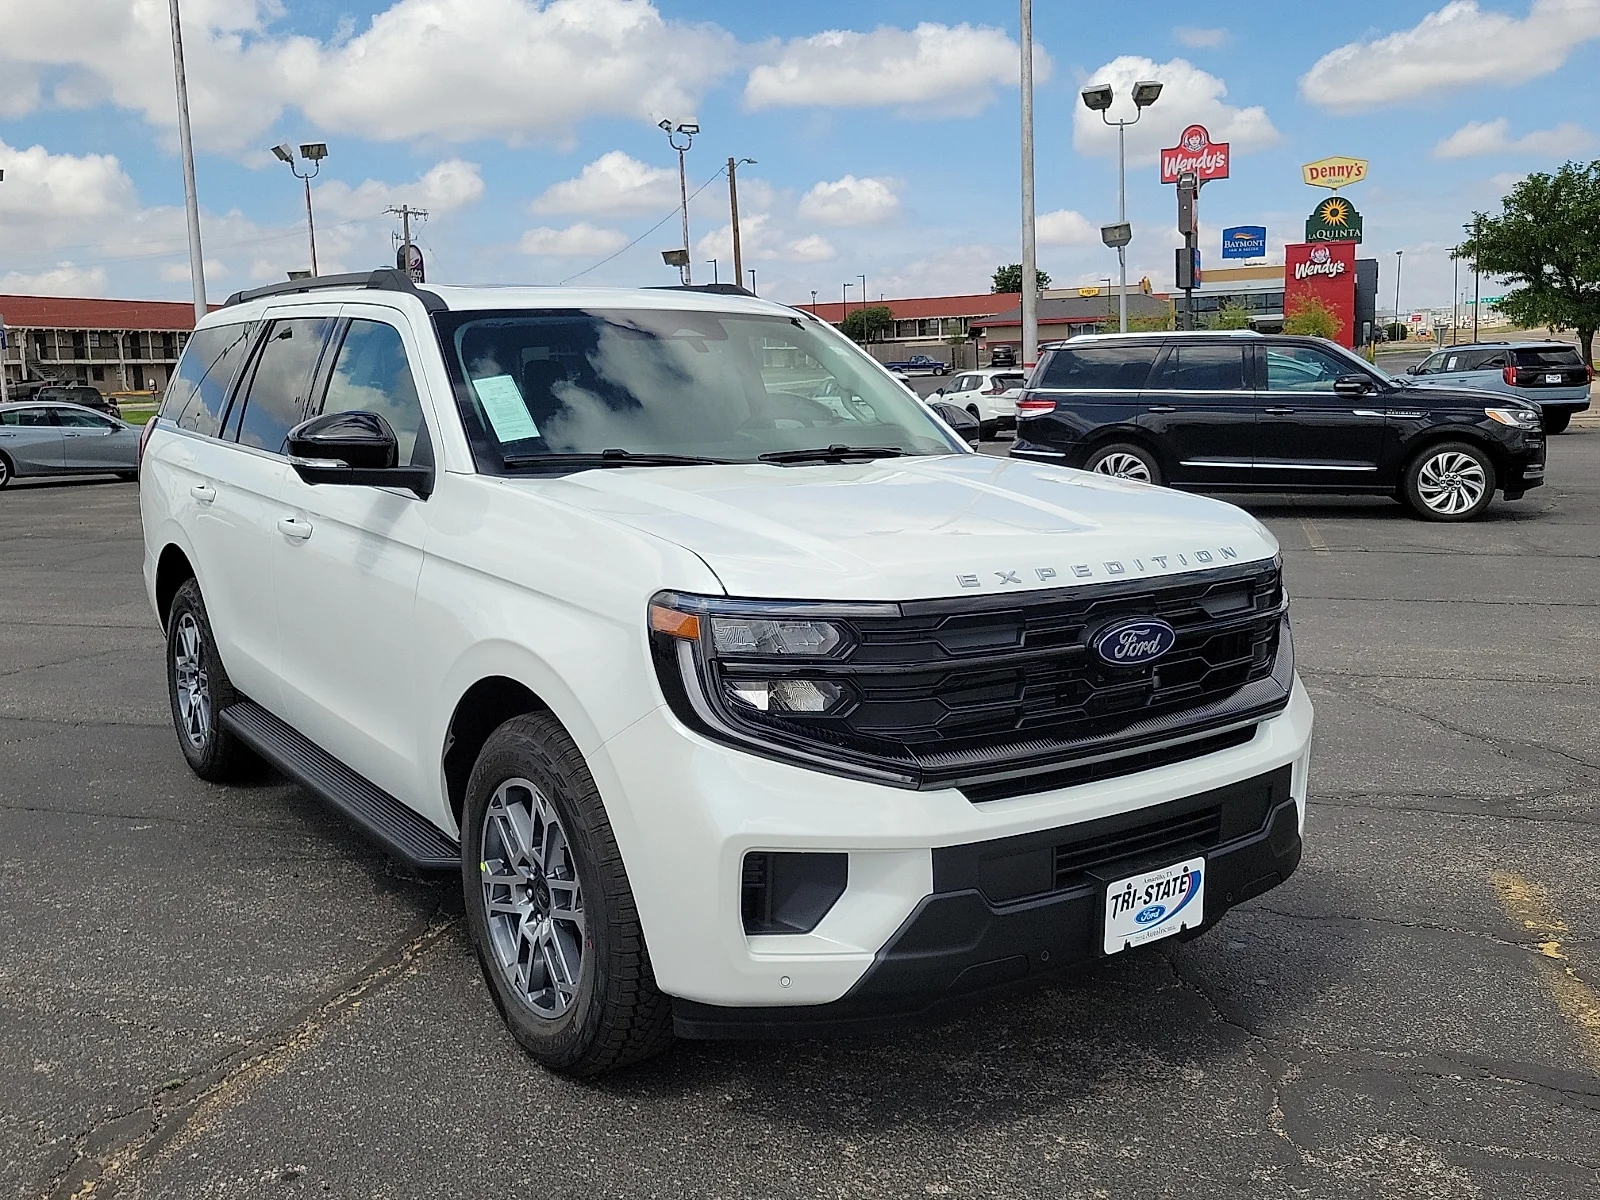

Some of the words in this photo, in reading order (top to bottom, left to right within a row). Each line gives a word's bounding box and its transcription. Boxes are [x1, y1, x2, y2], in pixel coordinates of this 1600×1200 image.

[1164, 148, 1226, 178] Wendy's
[1308, 163, 1363, 180] Denny's
[1224, 240, 1264, 249] BAYMONT
[1316, 228, 1362, 241] QUINTA
[1295, 258, 1345, 280] Wendy's
[956, 546, 1238, 588] EXPEDITION
[1114, 629, 1162, 659] Ford
[1110, 873, 1189, 920] TRI-STATE
[1141, 908, 1161, 922] Ford
